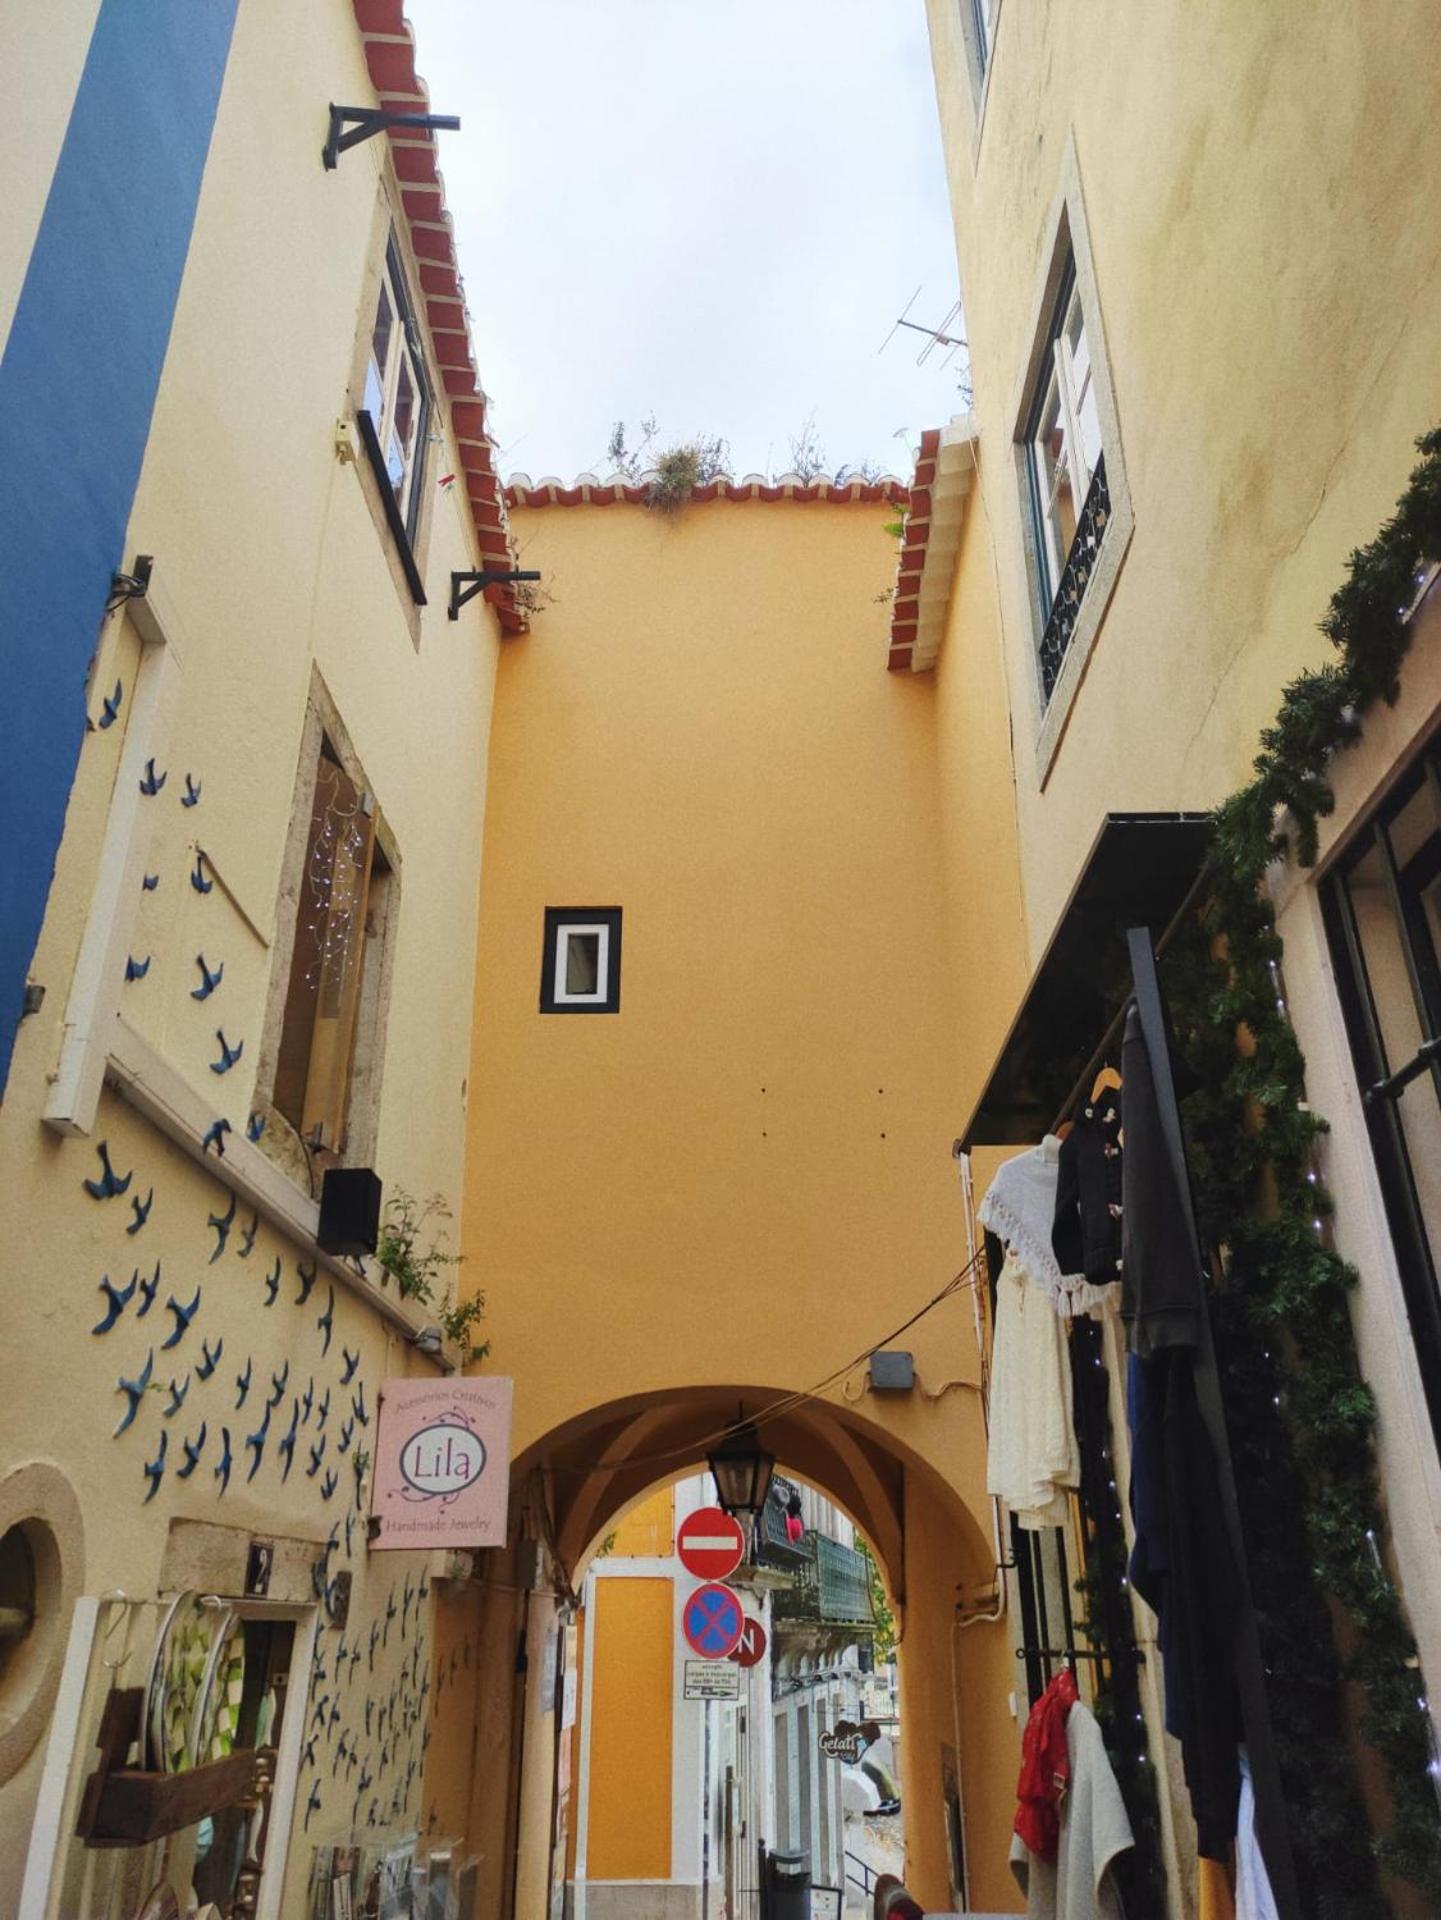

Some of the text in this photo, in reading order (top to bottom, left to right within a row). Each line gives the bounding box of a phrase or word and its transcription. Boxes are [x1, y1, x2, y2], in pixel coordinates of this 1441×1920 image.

[414, 1437, 469, 1480] Lila
[386, 1515, 490, 1533] Handmade Jewelry
[254, 1549, 267, 1593] 2
[738, 1628, 755, 1655] N
